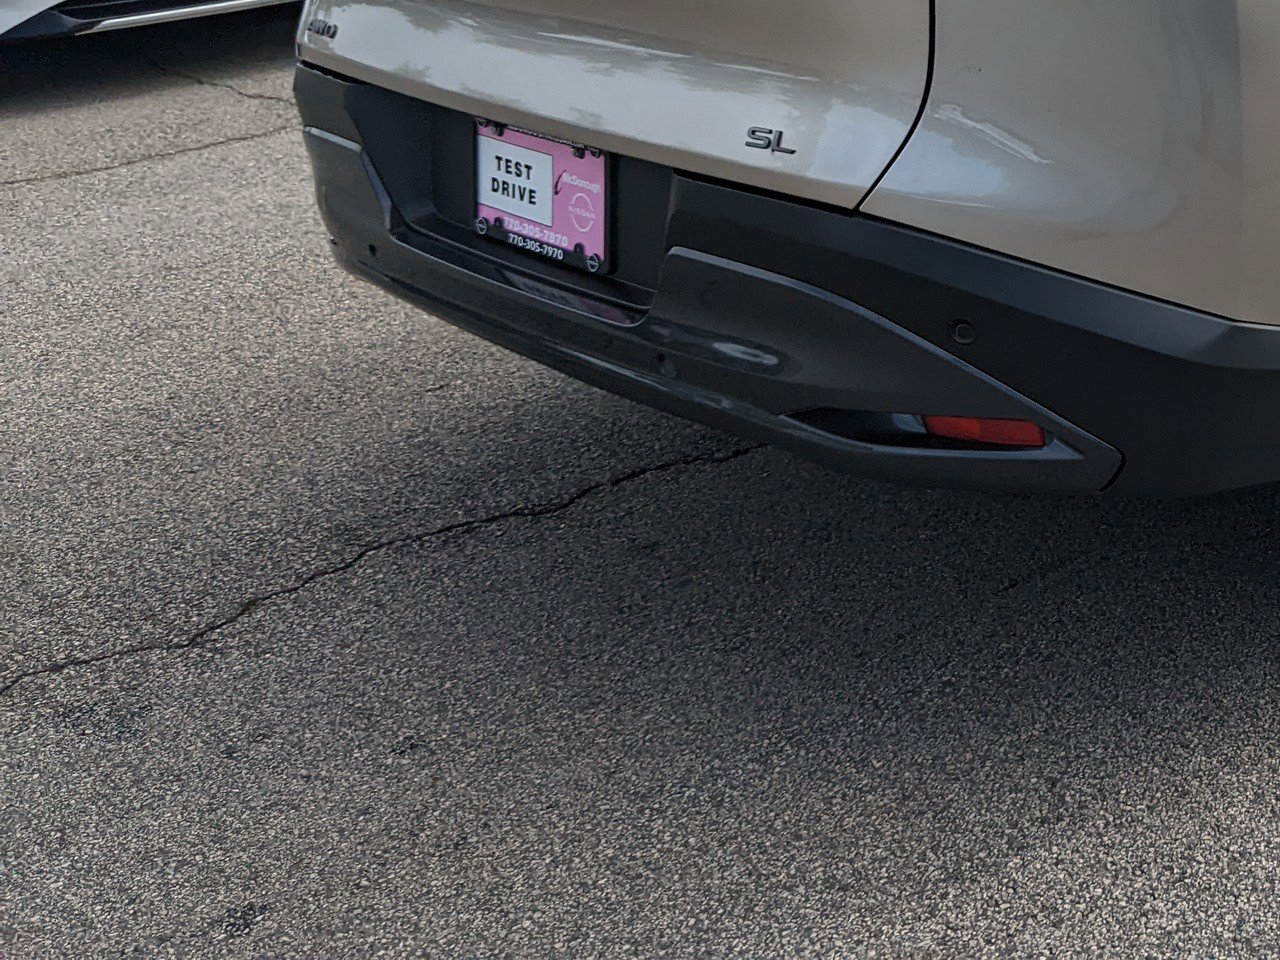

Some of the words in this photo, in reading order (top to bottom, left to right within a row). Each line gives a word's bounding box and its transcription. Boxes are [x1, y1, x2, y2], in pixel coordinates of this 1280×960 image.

[745, 126, 797, 155] SL
[494, 155, 533, 180] TEST
[491, 177, 537, 205] DRIVE
[504, 217, 568, 246] 770-305-7970
[508, 233, 564, 260] 770-305-7970
